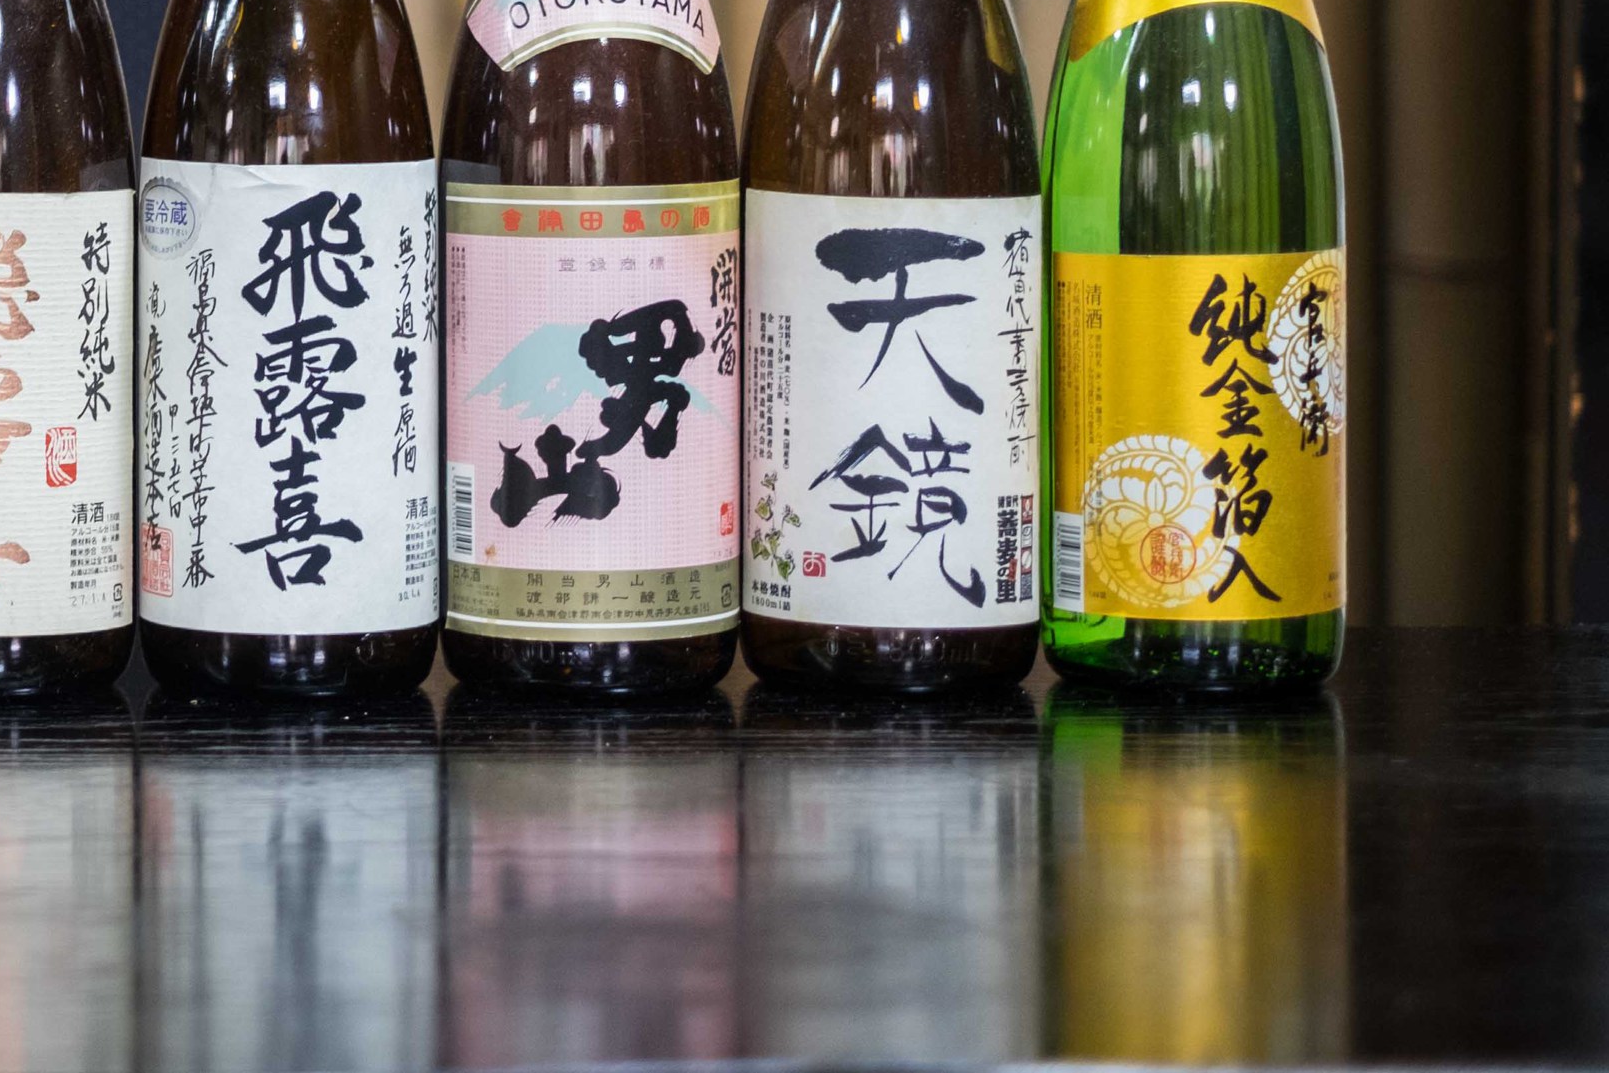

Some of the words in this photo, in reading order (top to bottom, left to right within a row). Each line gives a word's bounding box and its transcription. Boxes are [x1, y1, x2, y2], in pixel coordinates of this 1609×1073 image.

[145, 199, 187, 225] 要冷蔵
[501, 205, 710, 233] 會津田島の酒
[558, 256, 665, 272] 登録商標
[1086, 283, 1102, 330] 清酒
[77, 221, 115, 422] 特別純米
[230, 191, 374, 591] 飛露喜
[491, 298, 705, 528] 男山
[809, 228, 986, 608] 天鏡
[1190, 274, 1281, 603] 純金箔入
[72, 502, 104, 524] 清酒
[406, 496, 428, 519] 清酒
[996, 509, 1018, 604] 蕎麦の里
[71, 579, 96, 589] 製造年月
[453, 563, 481, 582] 日本酒
[527, 569, 700, 589] 開当男山酒造
[527, 587, 702, 605] 渡部謙一醸造元
[752, 579, 791, 598] 本格焼酎
